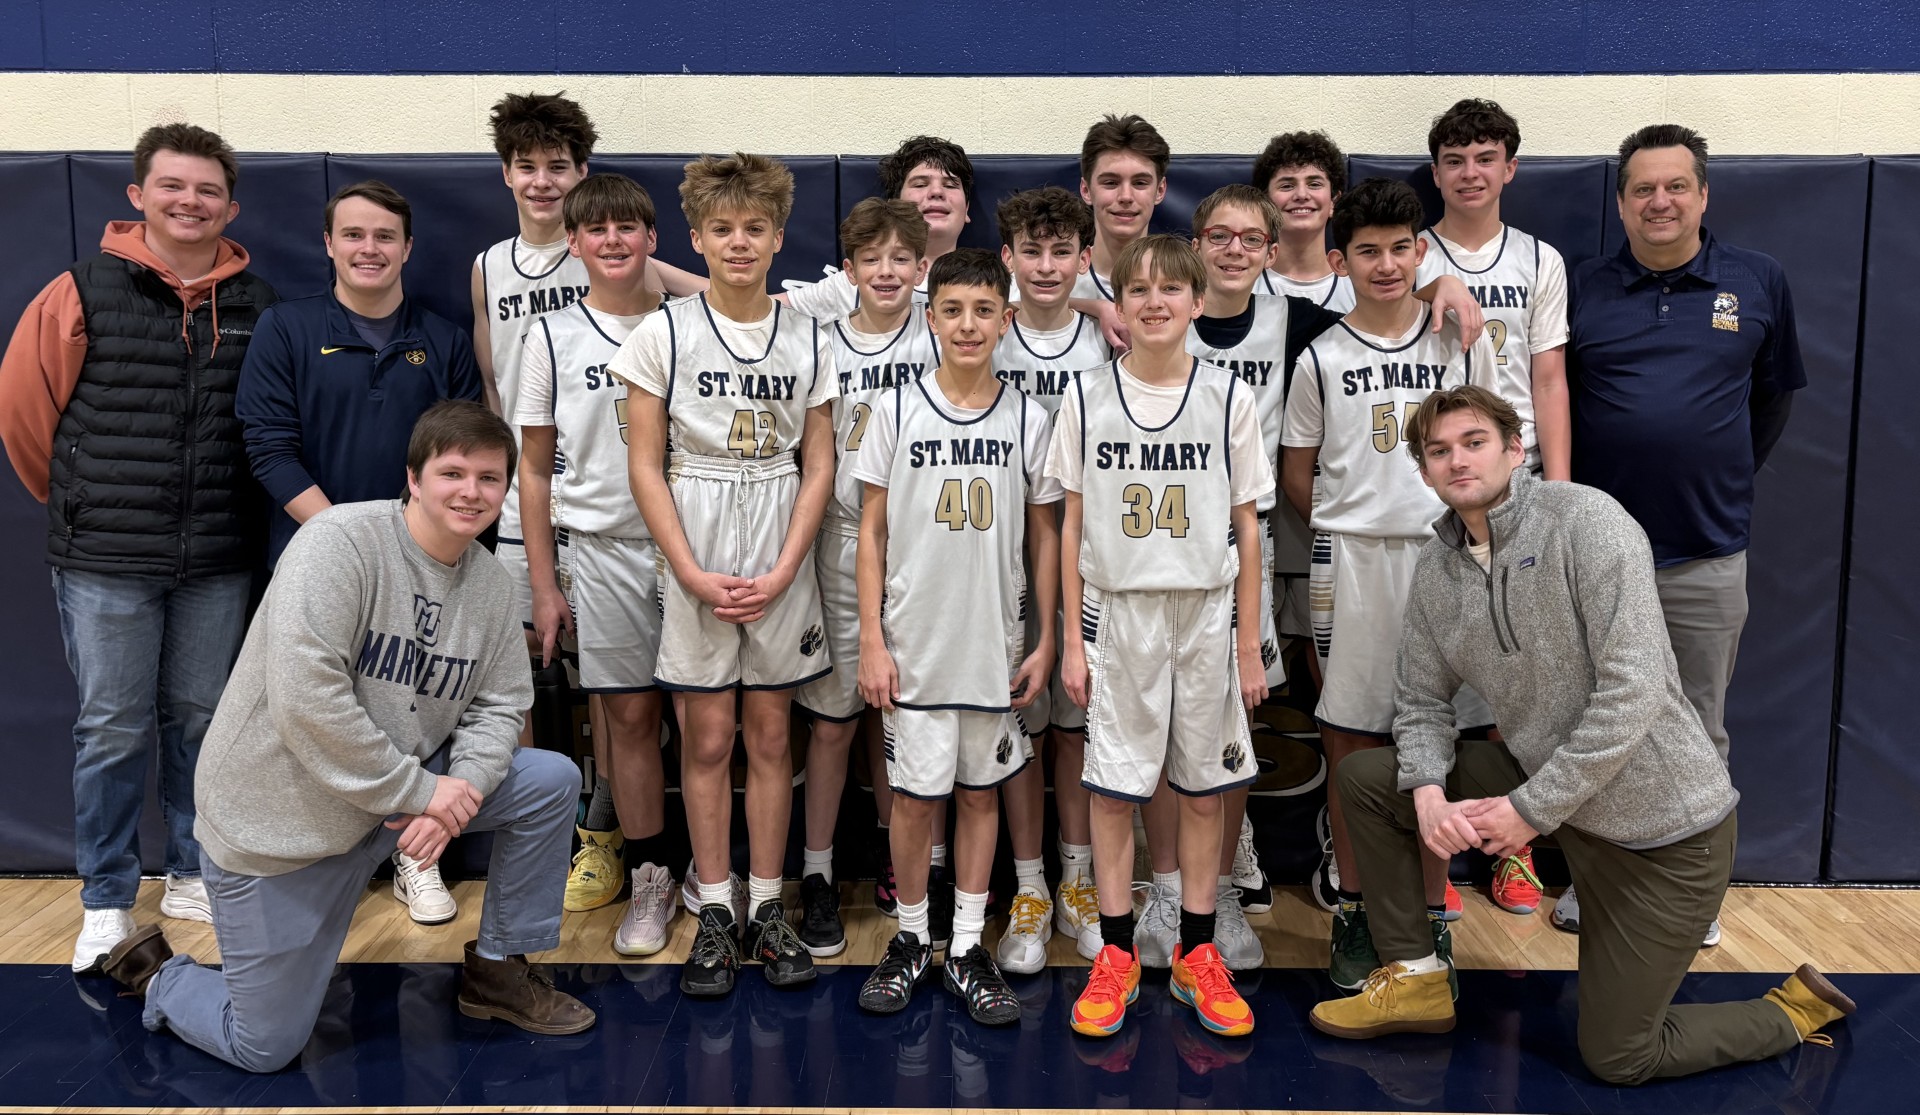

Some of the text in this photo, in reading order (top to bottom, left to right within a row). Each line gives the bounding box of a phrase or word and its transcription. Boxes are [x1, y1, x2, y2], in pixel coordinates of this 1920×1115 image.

[498, 286, 590, 321] ST. MARY
[1468, 285, 1528, 309] MARY
[698, 371, 796, 400] ST. MARY
[861, 363, 924, 390] MARY
[1342, 362, 1447, 396] ST. MARY
[727, 409, 779, 458] 42
[910, 438, 1014, 468] ST. MARY
[1096, 442, 1211, 471] ST. MARY
[935, 477, 993, 531] 40
[1122, 483, 1190, 538] 34
